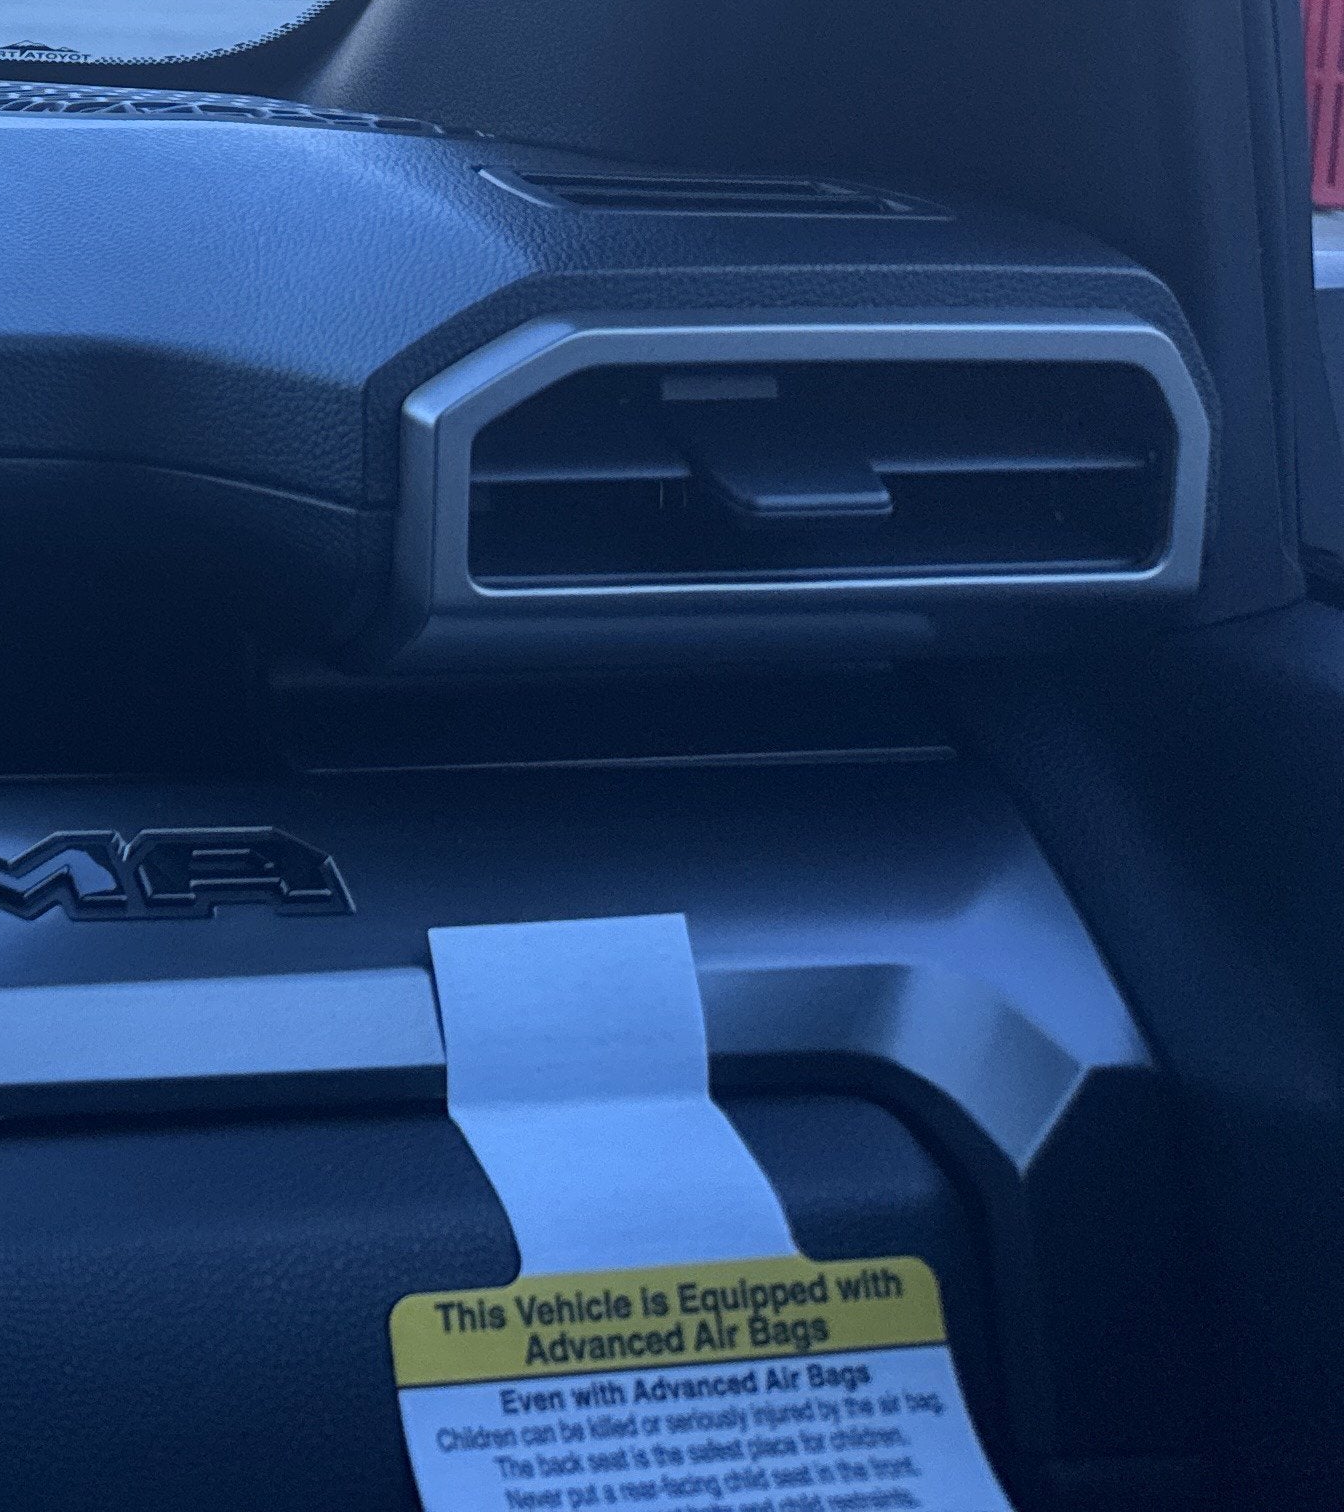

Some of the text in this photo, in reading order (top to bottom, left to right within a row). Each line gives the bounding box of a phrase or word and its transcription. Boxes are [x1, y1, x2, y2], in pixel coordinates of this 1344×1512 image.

[435, 1268, 904, 1333] This Vehicle is Equipped with
[525, 1315, 830, 1365] Advanced Air Bags
[500, 1363, 872, 1415] Even with Advanced Air Bags
[435, 1426, 516, 1453] Children
[521, 1423, 556, 1447] can
[559, 1419, 585, 1443] be
[587, 1413, 638, 1440] killed
[640, 1415, 660, 1436] or
[665, 1408, 748, 1435] seriously
[750, 1399, 814, 1429] injured
[816, 1397, 841, 1426] by
[842, 1395, 875, 1416] the
[877, 1390, 900, 1414] air
[493, 1454, 535, 1479] The
[535, 1450, 584, 1478] back
[587, 1447, 630, 1473] seat
[651, 1441, 685, 1467] the
[686, 1438, 745, 1464] safest
[746, 1435, 799, 1463] place
[798, 1429, 827, 1455] for
[505, 1486, 563, 1511] Never
[723, 1466, 770, 1493] child
[835, 1457, 869, 1483] the
